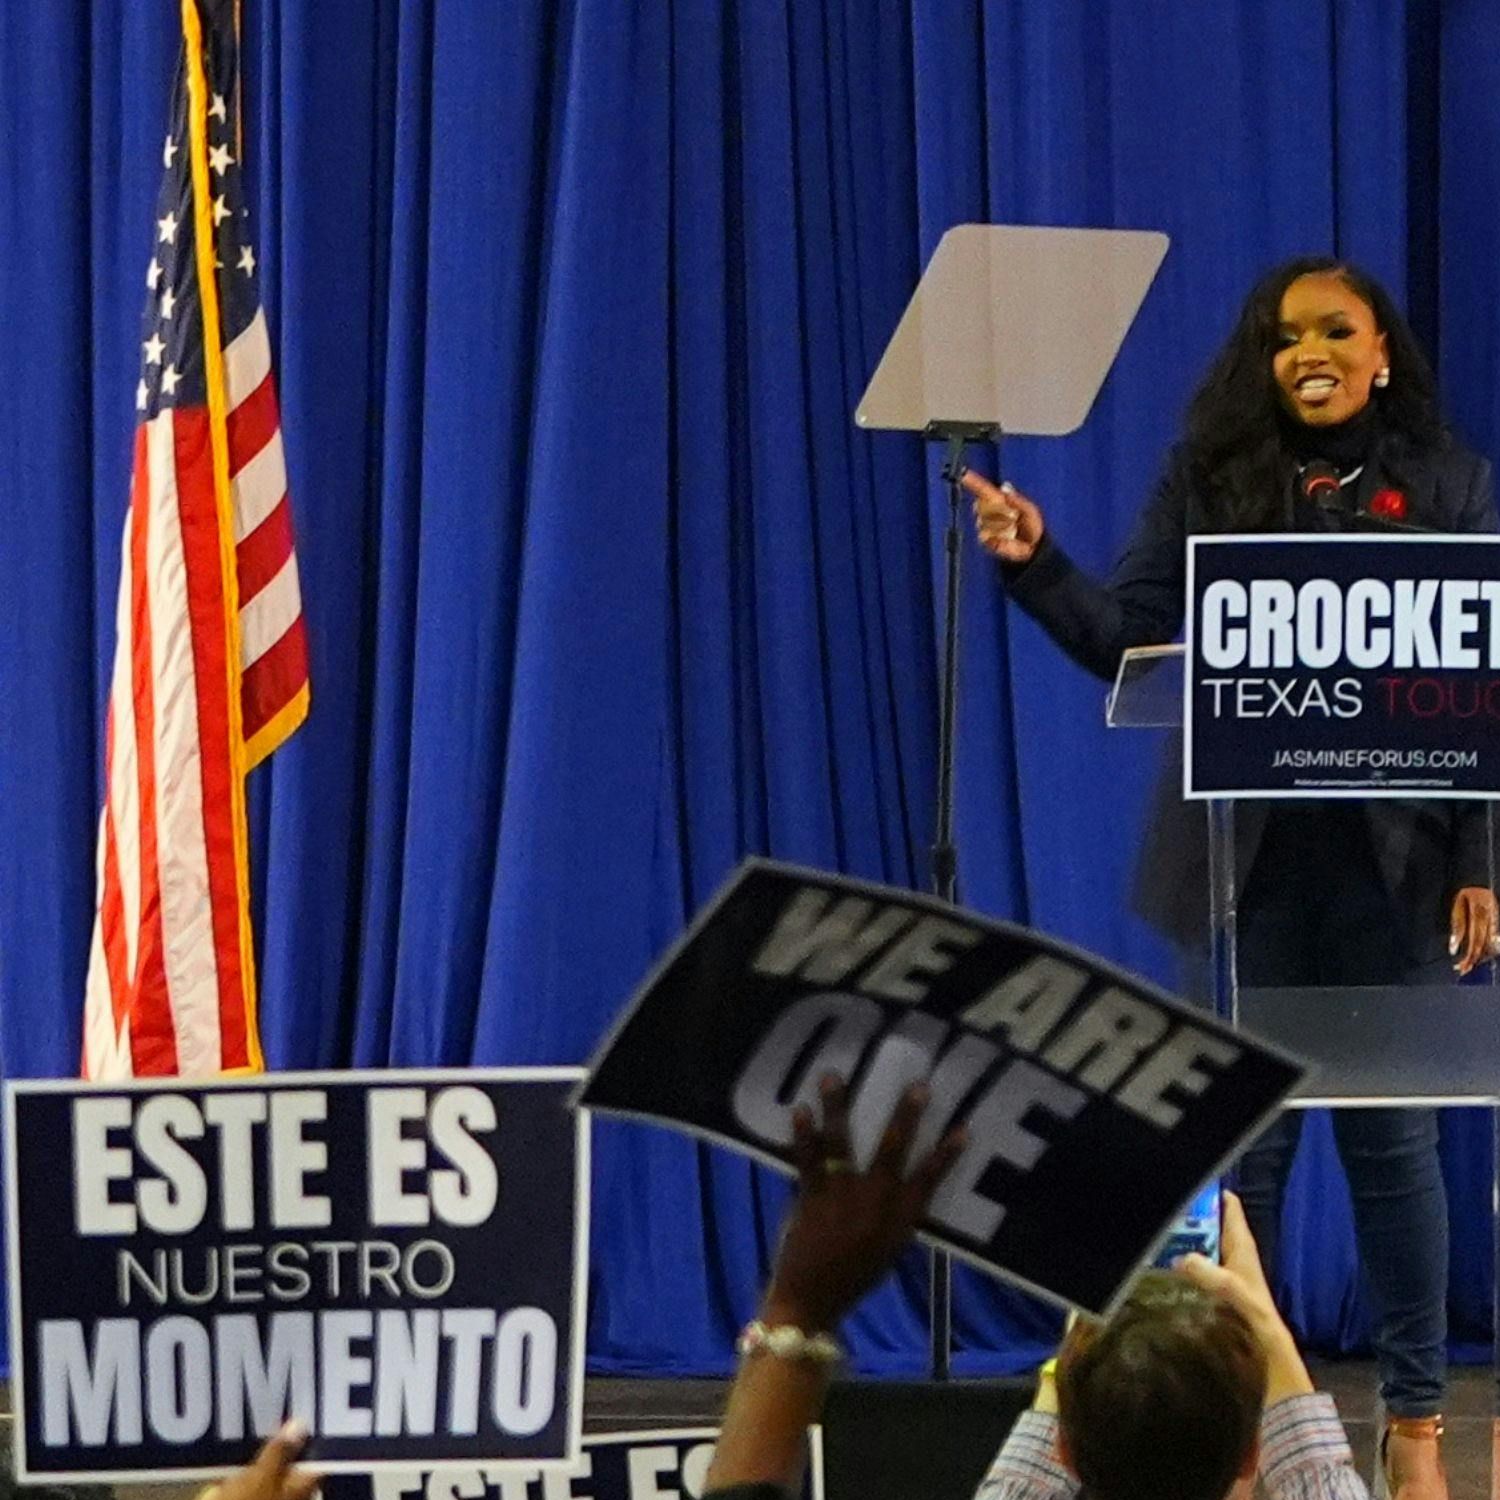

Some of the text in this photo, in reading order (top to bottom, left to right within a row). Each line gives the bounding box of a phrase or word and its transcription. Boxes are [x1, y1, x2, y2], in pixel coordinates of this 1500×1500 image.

[1201, 678, 1363, 718] TEXAS
[1272, 749, 1478, 768] JASMINEFORUS.COM
[753, 887, 1244, 1130] WE ARE
[73, 1086, 499, 1237] ESTE ES
[117, 1239, 456, 1306] NUESTRO
[38, 1306, 558, 1448] MOMENTO
